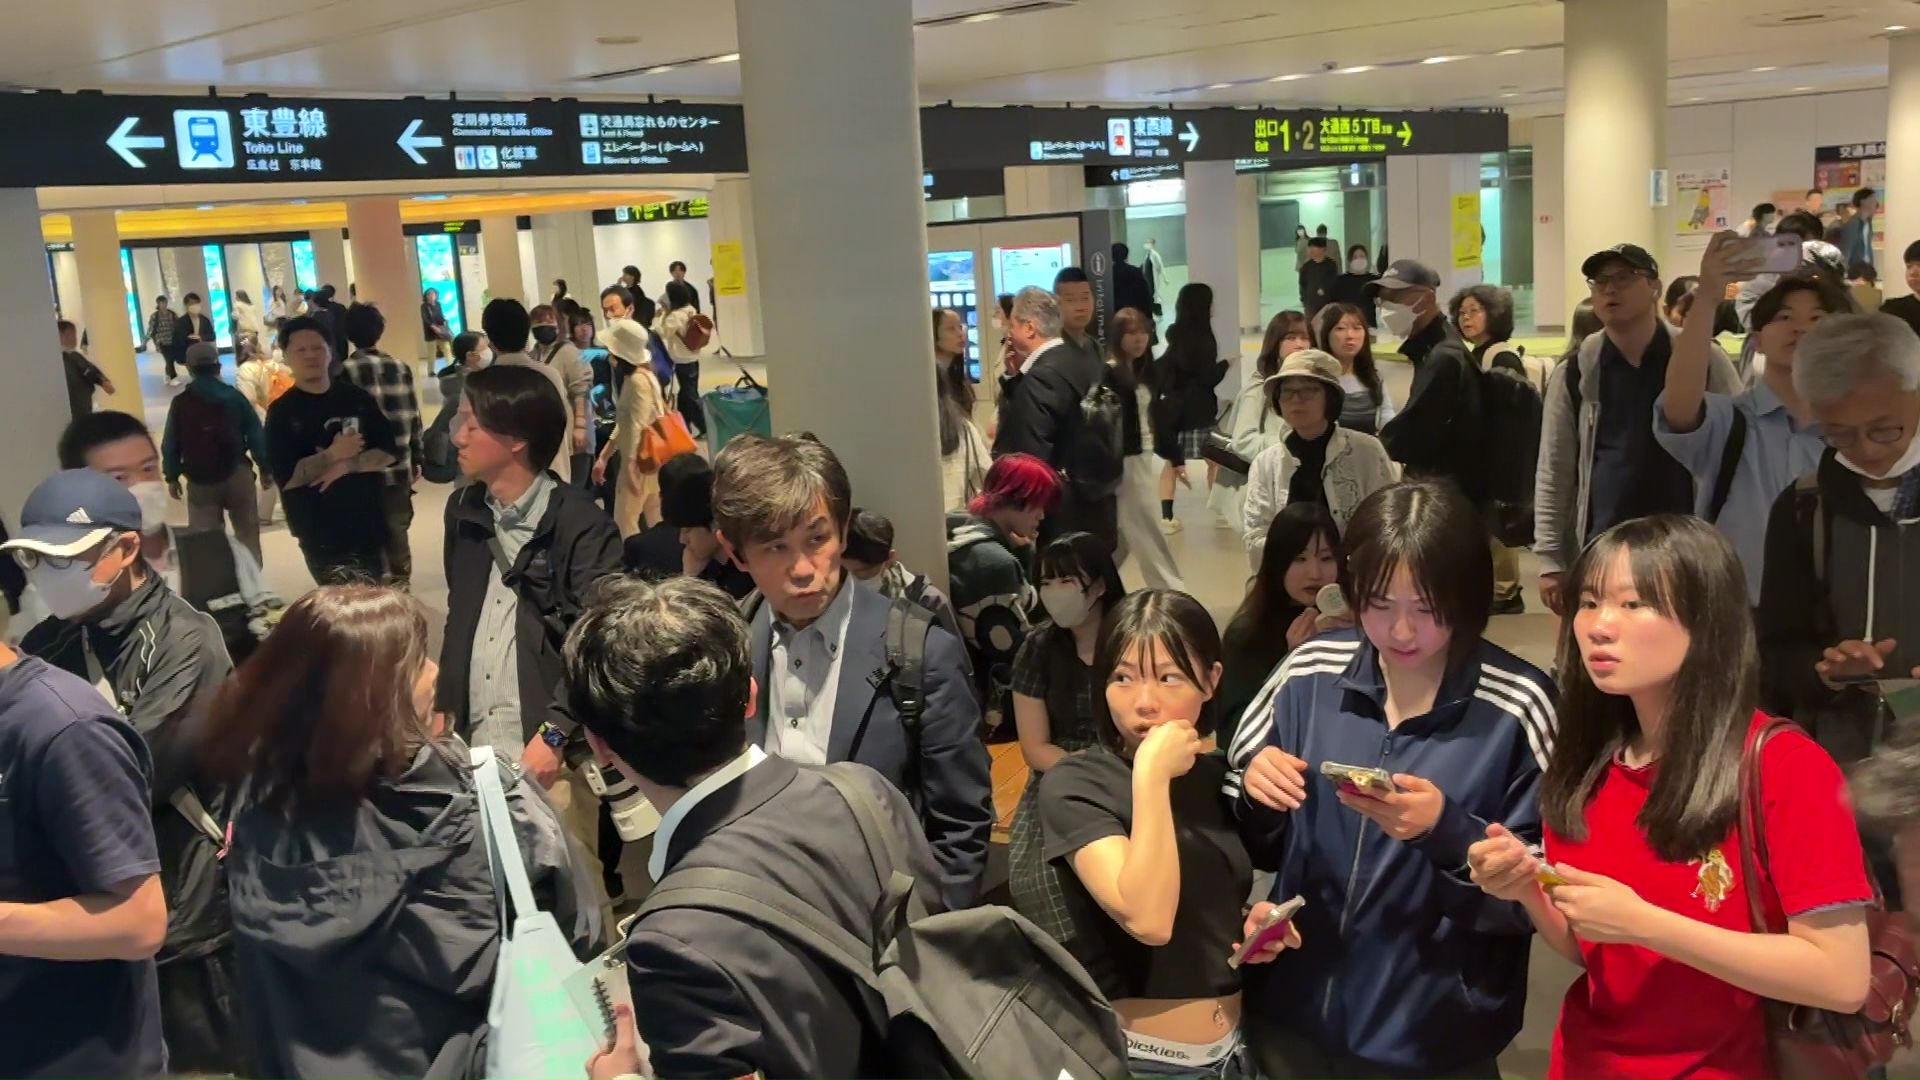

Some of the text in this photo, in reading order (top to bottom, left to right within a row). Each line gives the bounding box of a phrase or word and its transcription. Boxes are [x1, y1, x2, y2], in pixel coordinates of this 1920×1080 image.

[240, 107, 327, 138] 東豊線
[1255, 119, 1278, 138] 出口
[242, 142, 304, 155] Toho Line
